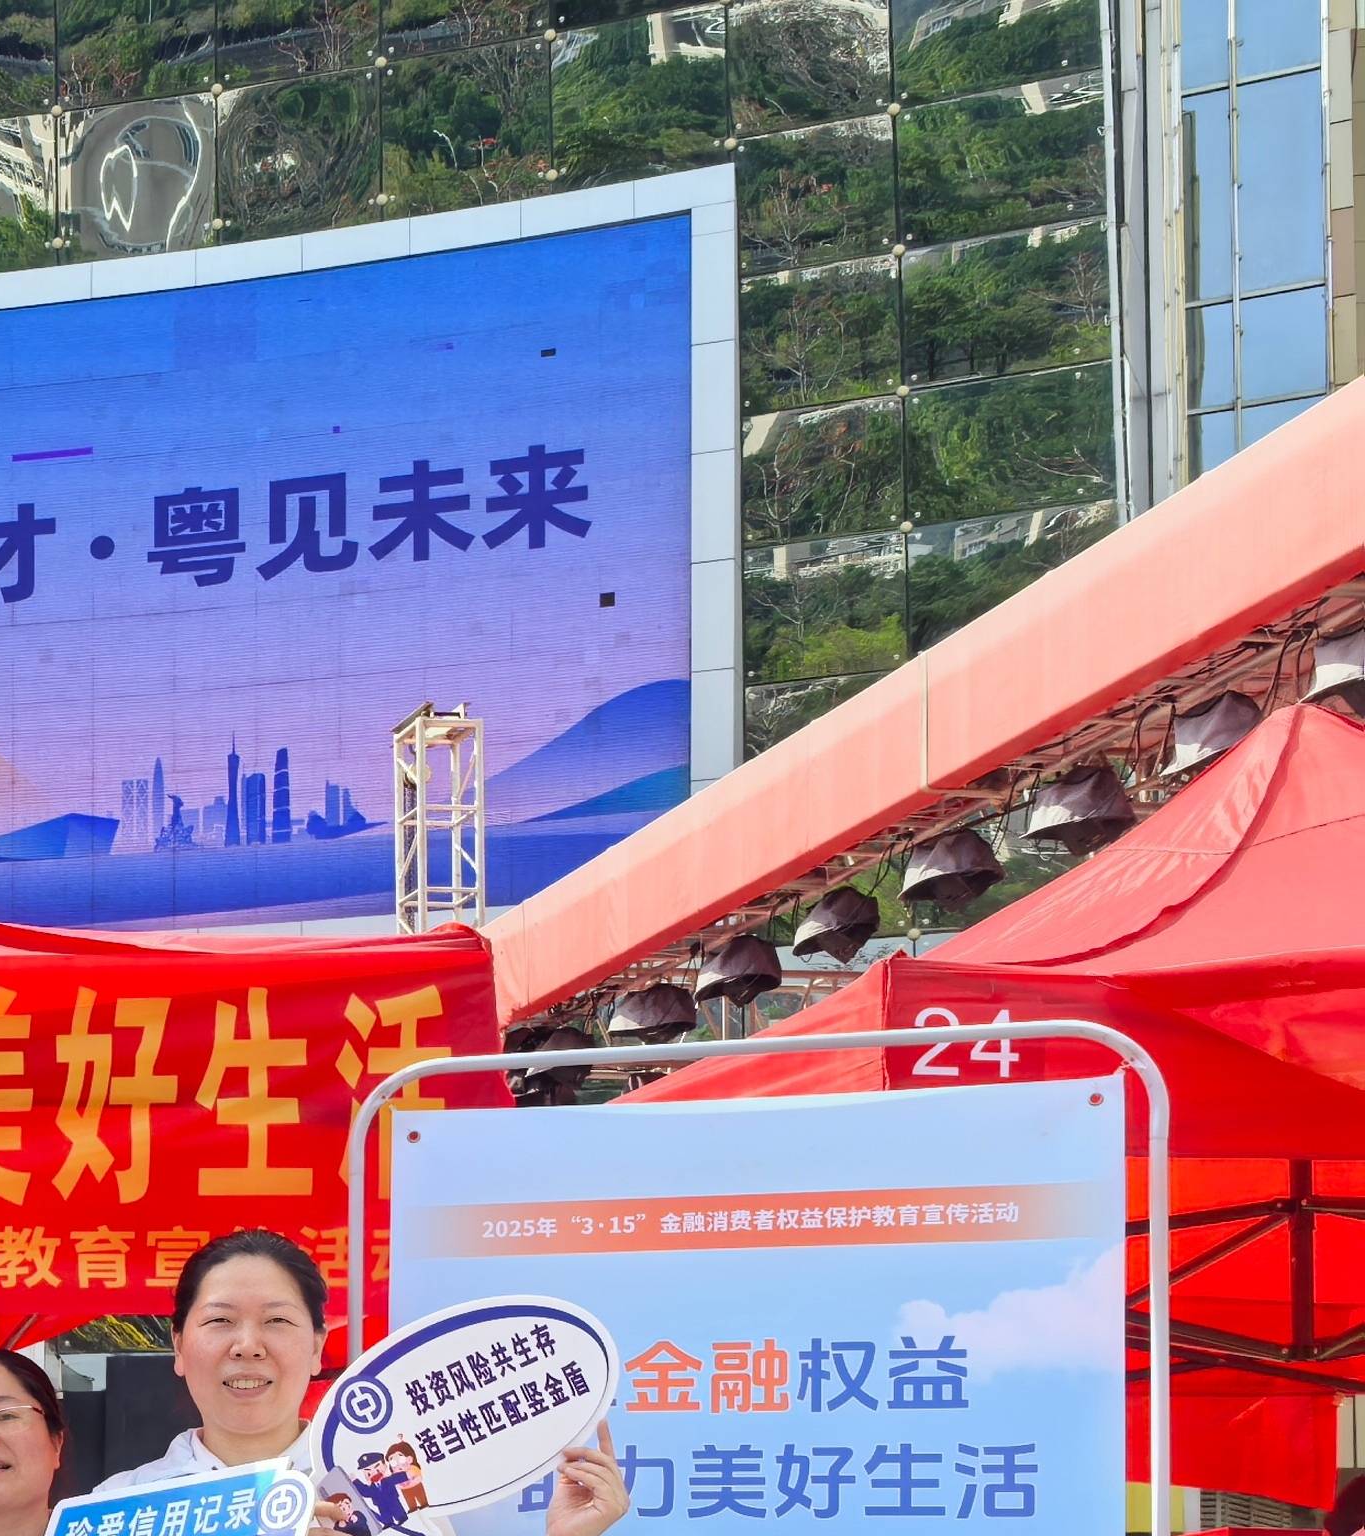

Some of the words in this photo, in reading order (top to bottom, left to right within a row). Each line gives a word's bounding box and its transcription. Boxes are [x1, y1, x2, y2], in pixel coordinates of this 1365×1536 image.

[912, 1007, 1019, 1078] 24
[406, 1324, 556, 1416] 投资风险共生存
[610, 1336, 971, 1413] 金融权益
[415, 1360, 590, 1464] 适当性匹配竖金盾
[518, 1443, 1039, 1520] 力美好生活
